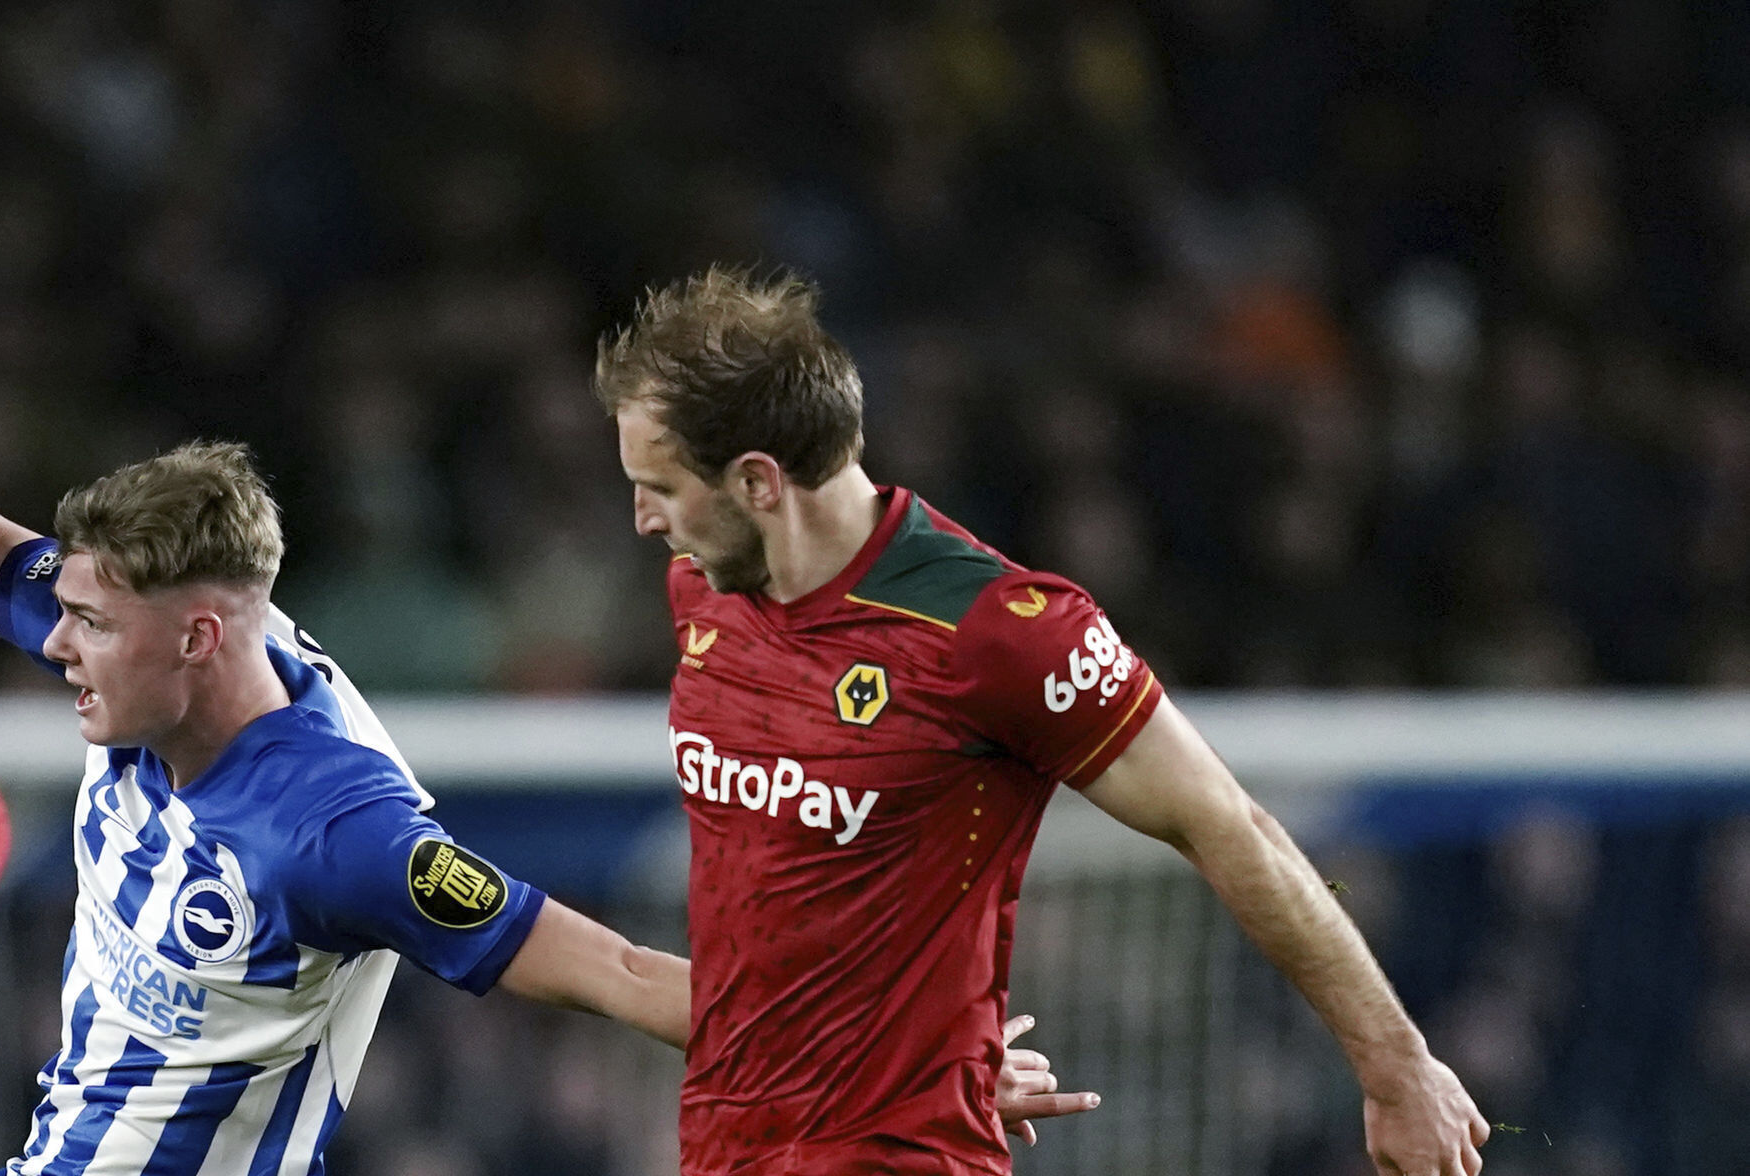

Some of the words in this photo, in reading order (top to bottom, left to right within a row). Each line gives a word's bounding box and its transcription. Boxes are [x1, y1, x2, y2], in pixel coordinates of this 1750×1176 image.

[413, 844, 456, 898] SNICKERS
[446, 863, 481, 902] UK
[229, 896, 240, 916] HOVE
[186, 944, 213, 958] ALBION
